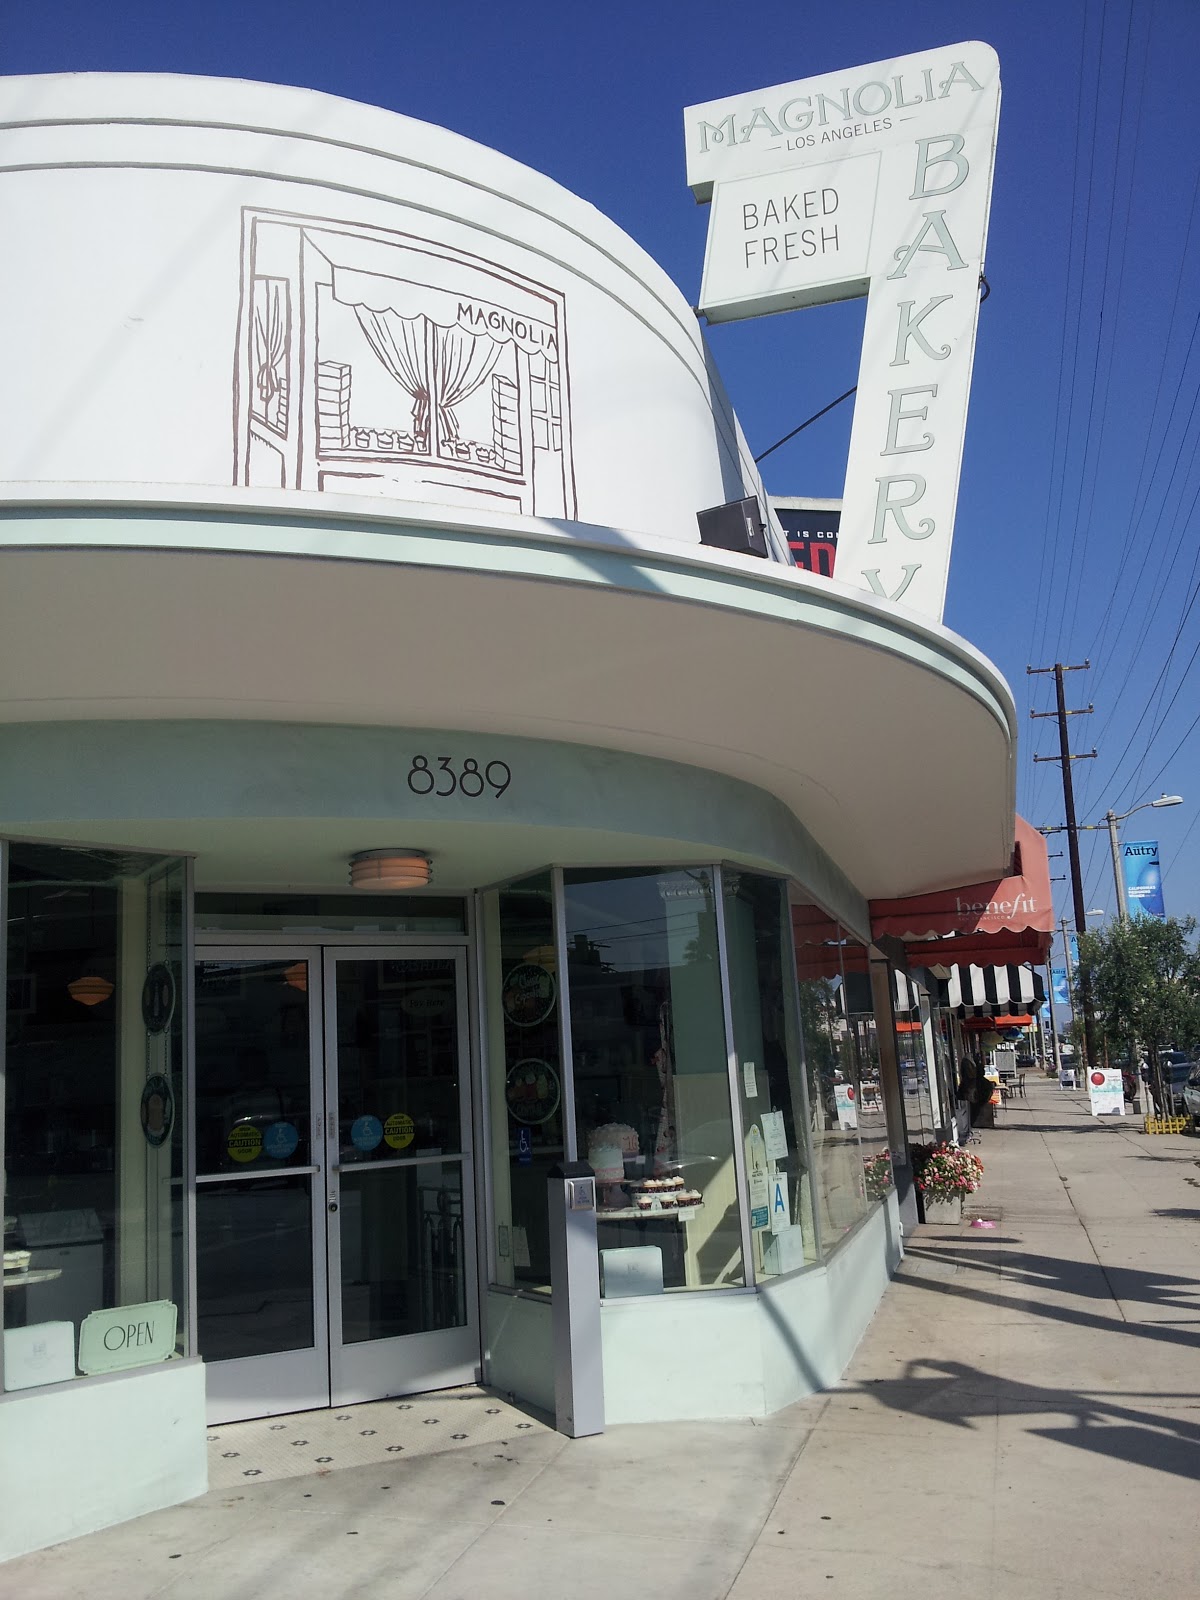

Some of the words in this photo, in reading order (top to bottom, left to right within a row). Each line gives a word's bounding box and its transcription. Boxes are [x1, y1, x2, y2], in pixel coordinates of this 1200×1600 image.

[698, 61, 985, 154] MAGNOLIA
[786, 134, 816, 151] LOS
[821, 117, 893, 145] ANGELES
[742, 187, 840, 231] BAKED
[744, 224, 840, 269] FRESH
[457, 302, 557, 351] MAGNOLIA
[797, 530, 810, 538] IS
[407, 754, 512, 799] 8389
[1124, 846, 1158, 857] Autry
[954, 892, 1038, 920] benefit
[228, 1137, 261, 1148] CAUTION
[384, 1126, 414, 1136] CAUTION
[774, 1183, 785, 1213] A
[103, 1320, 155, 1351] OPEN
